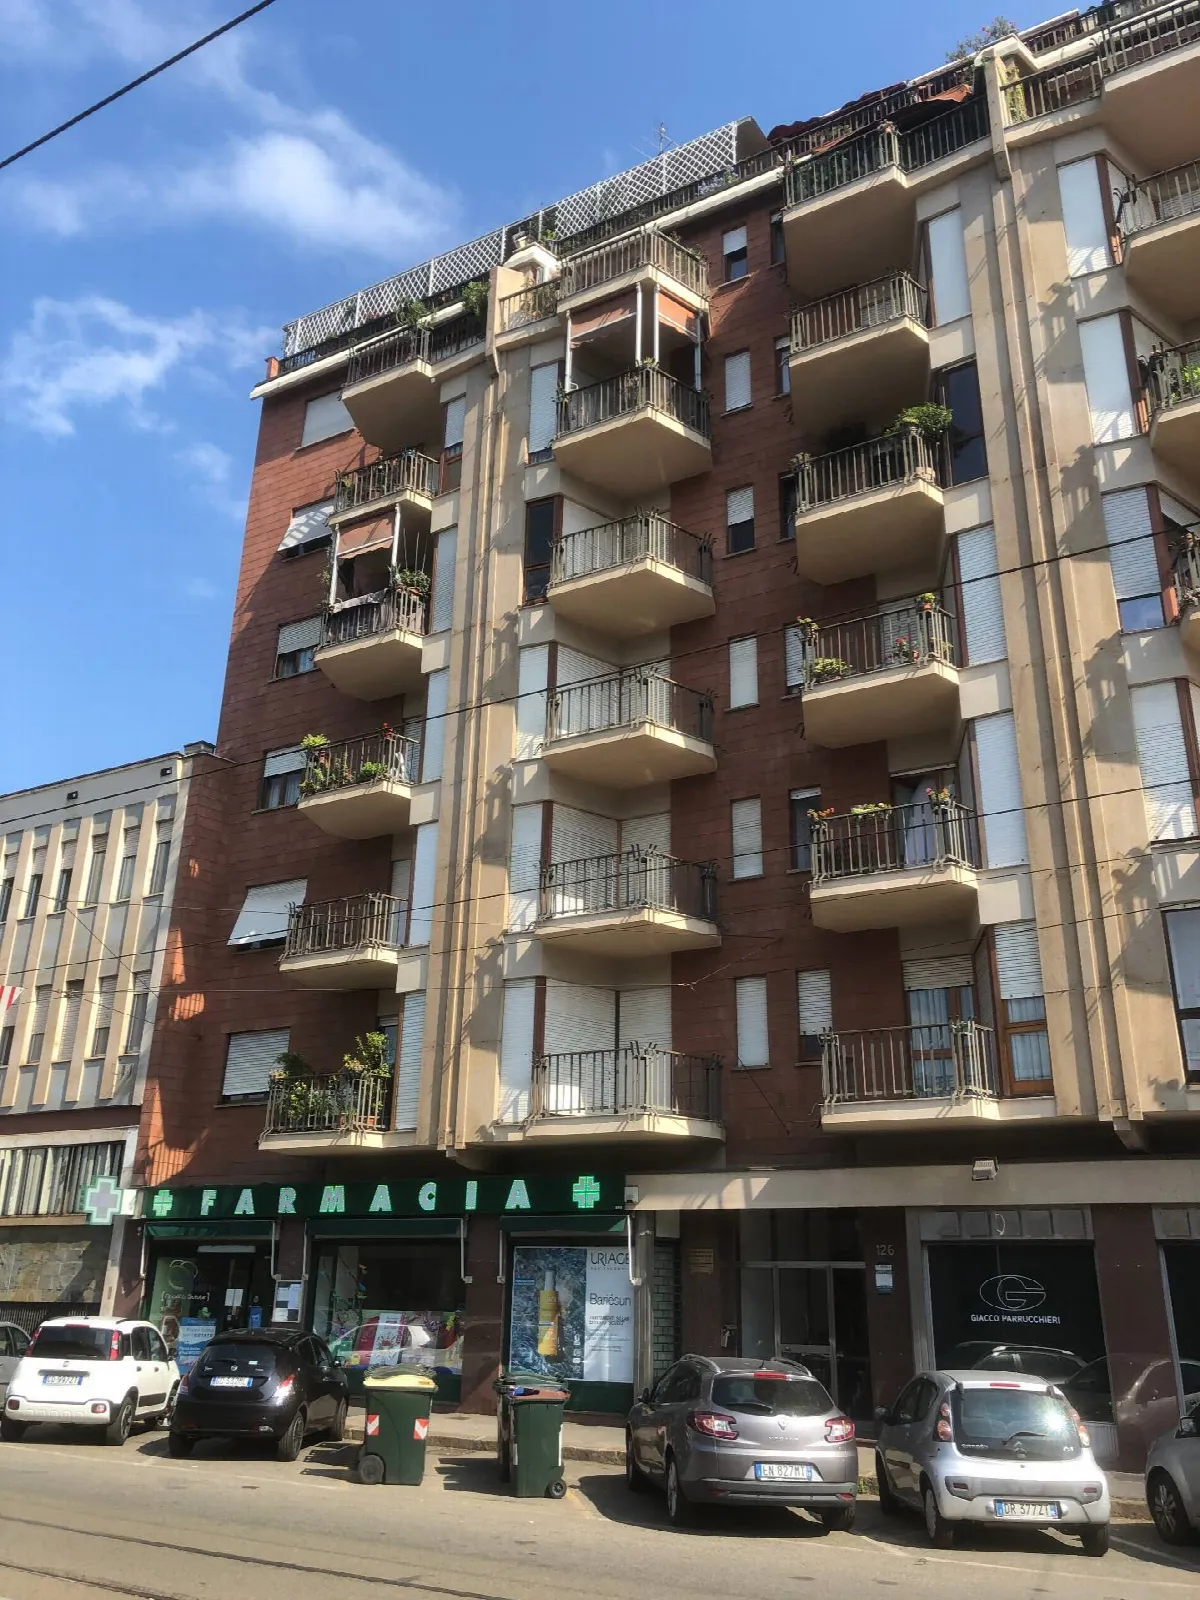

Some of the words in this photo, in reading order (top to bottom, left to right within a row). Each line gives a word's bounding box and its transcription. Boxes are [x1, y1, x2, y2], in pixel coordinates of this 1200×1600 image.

[200, 1179, 532, 1216] FARMACIA
[876, 1244, 895, 1256] 126
[970, 1314, 999, 1322] GIACCO
[1001, 1314, 1061, 1324] PARRUCCHIERI
[762, 1465, 774, 1476] EN
[1004, 1503, 1017, 1514] DR
